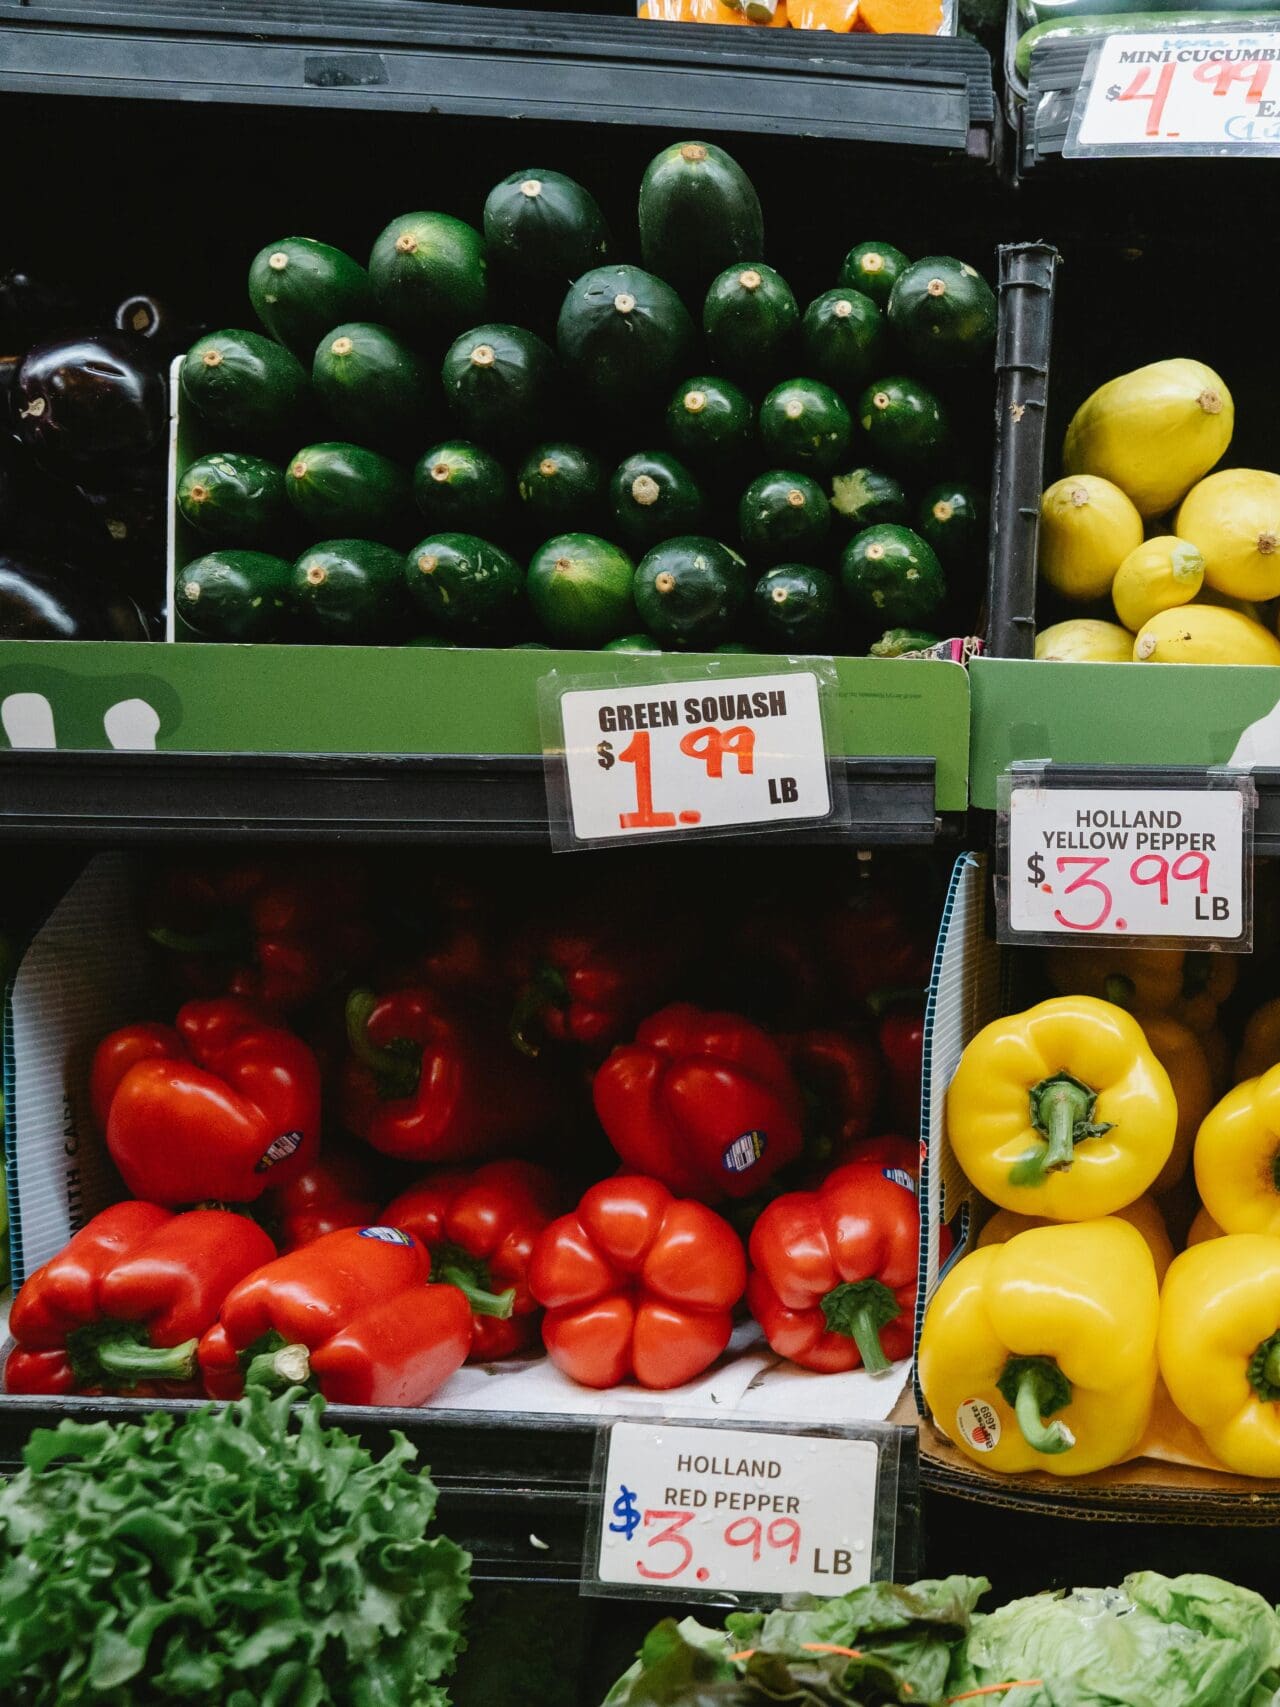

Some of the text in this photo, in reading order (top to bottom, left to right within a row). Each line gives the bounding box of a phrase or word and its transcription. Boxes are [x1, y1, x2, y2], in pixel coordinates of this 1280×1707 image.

[1119, 50, 1172, 64] MINI
[598, 690, 788, 732] GREEN SQUASH
[768, 777, 799, 805] LB
[1076, 809, 1182, 829] HOLLAND
[1043, 831, 1217, 852] YELLOW PEPPER
[1195, 896, 1230, 921] LB
[980, 1406, 997, 1430] 4689
[676, 1454, 782, 1479] HOLLAND
[664, 1487, 800, 1514] RED PEPPER
[813, 1548, 853, 1576] LB
